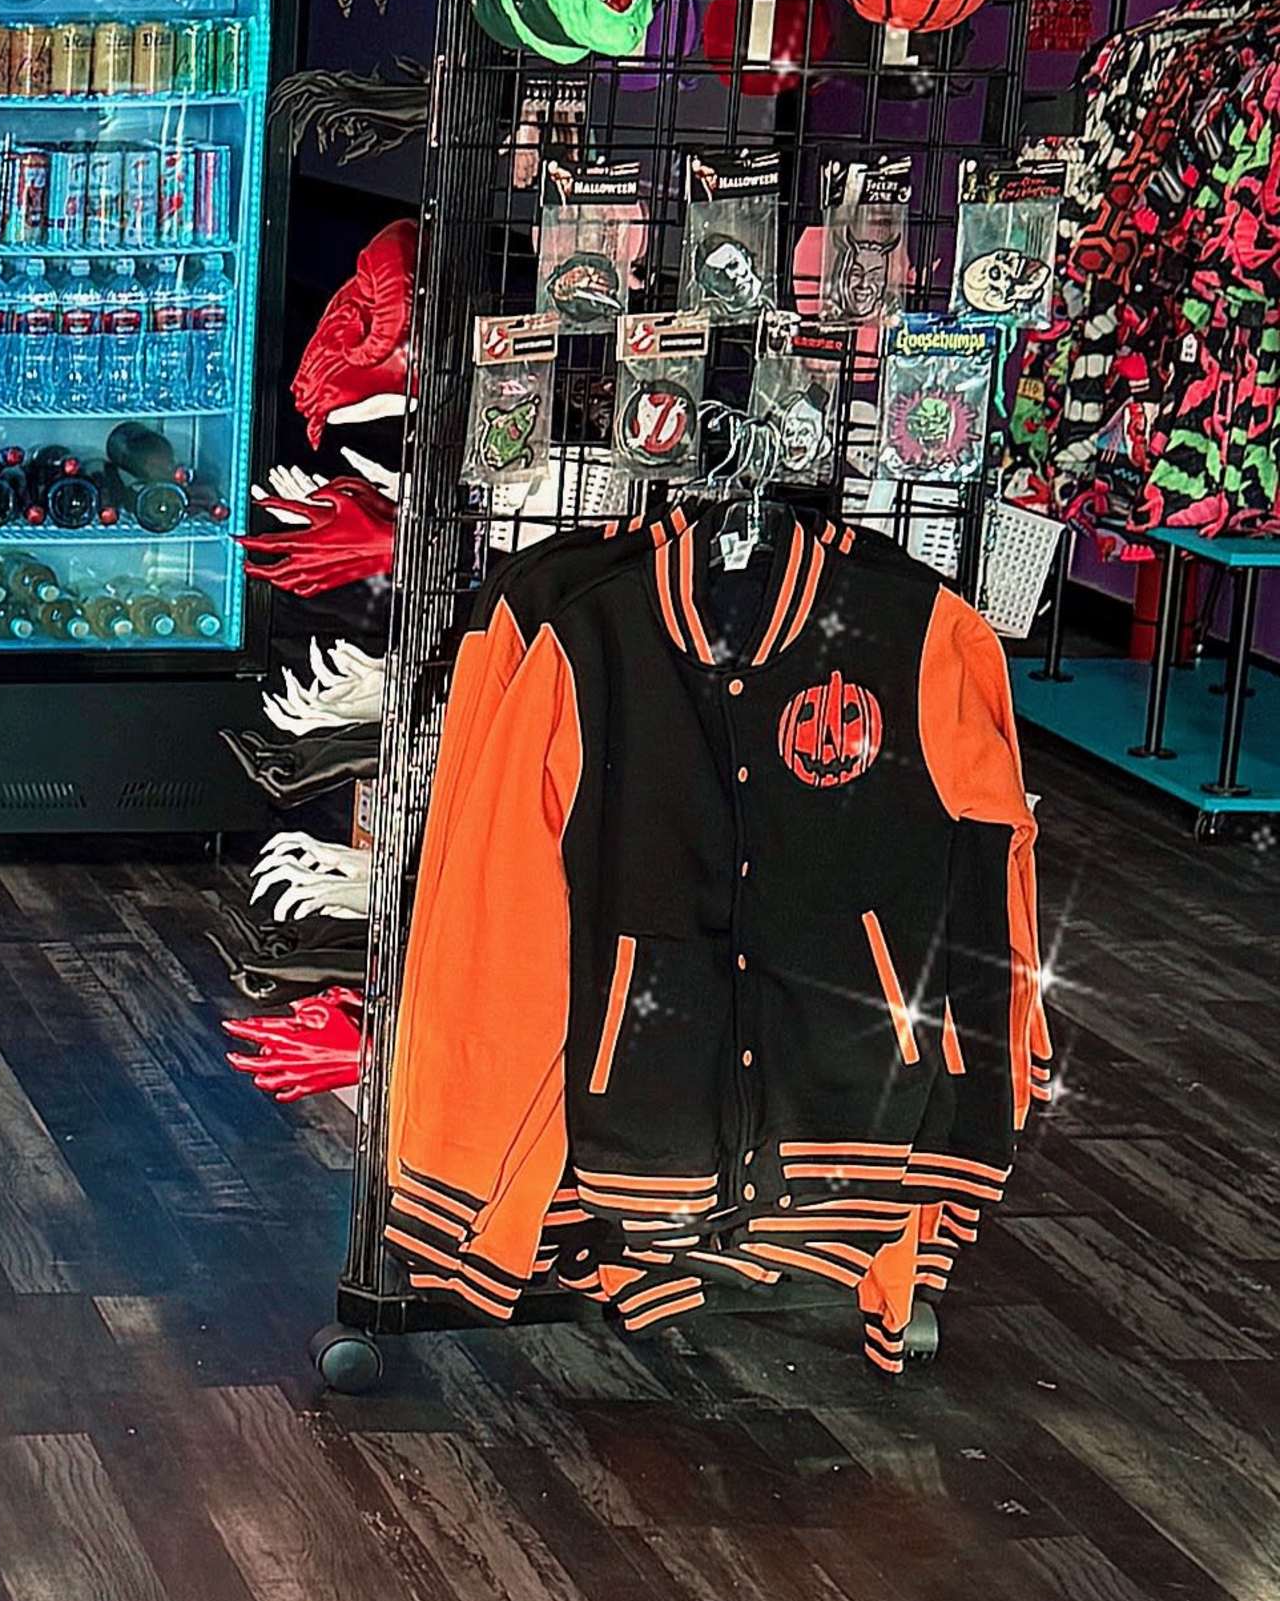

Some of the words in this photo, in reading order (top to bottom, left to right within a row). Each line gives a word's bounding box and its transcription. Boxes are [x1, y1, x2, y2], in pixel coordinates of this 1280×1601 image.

[574, 181, 637, 194] HALLOWEEN
[719, 172, 779, 189] HALLOWEEN
[896, 319, 986, 356] Goosebumps
